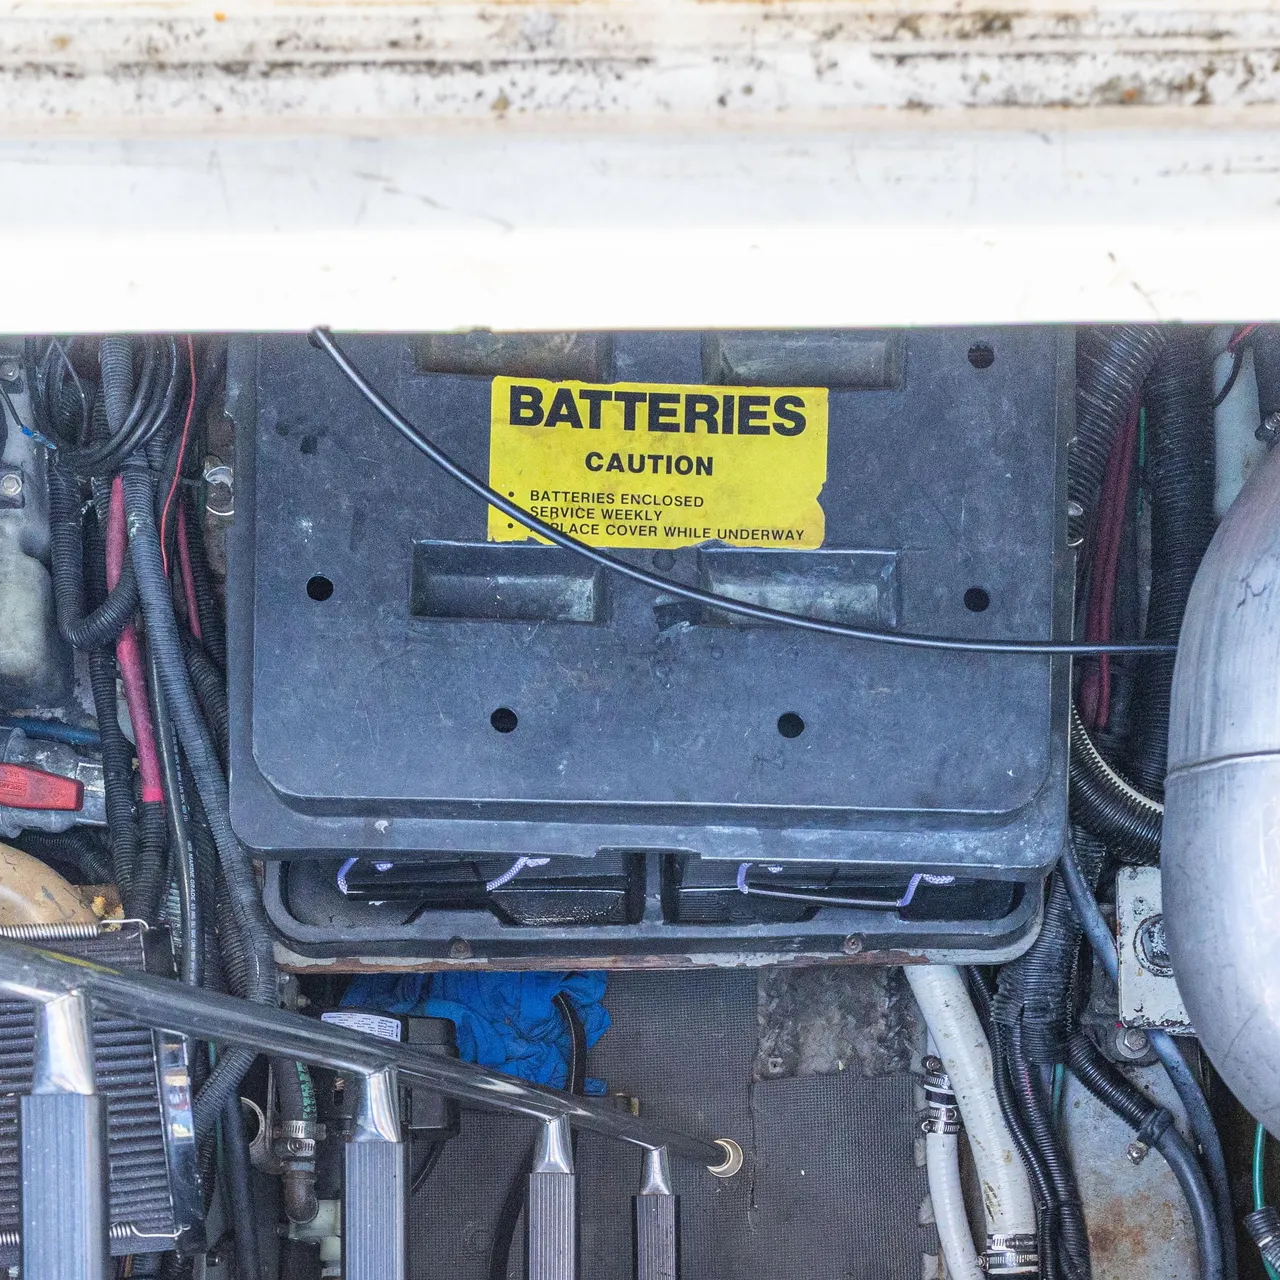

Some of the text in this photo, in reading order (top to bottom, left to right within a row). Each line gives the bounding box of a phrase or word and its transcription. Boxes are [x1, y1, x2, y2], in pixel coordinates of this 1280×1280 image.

[509, 384, 807, 437] BATTERIES
[585, 451, 714, 476] CAUTION
[530, 490, 704, 507] BATTERIES ENCLOSED
[530, 506, 663, 521] SERVICE WEEKLY
[605, 525, 657, 537] COVER
[664, 526, 711, 538] WHILE
[717, 528, 805, 541] UNDERWAY
